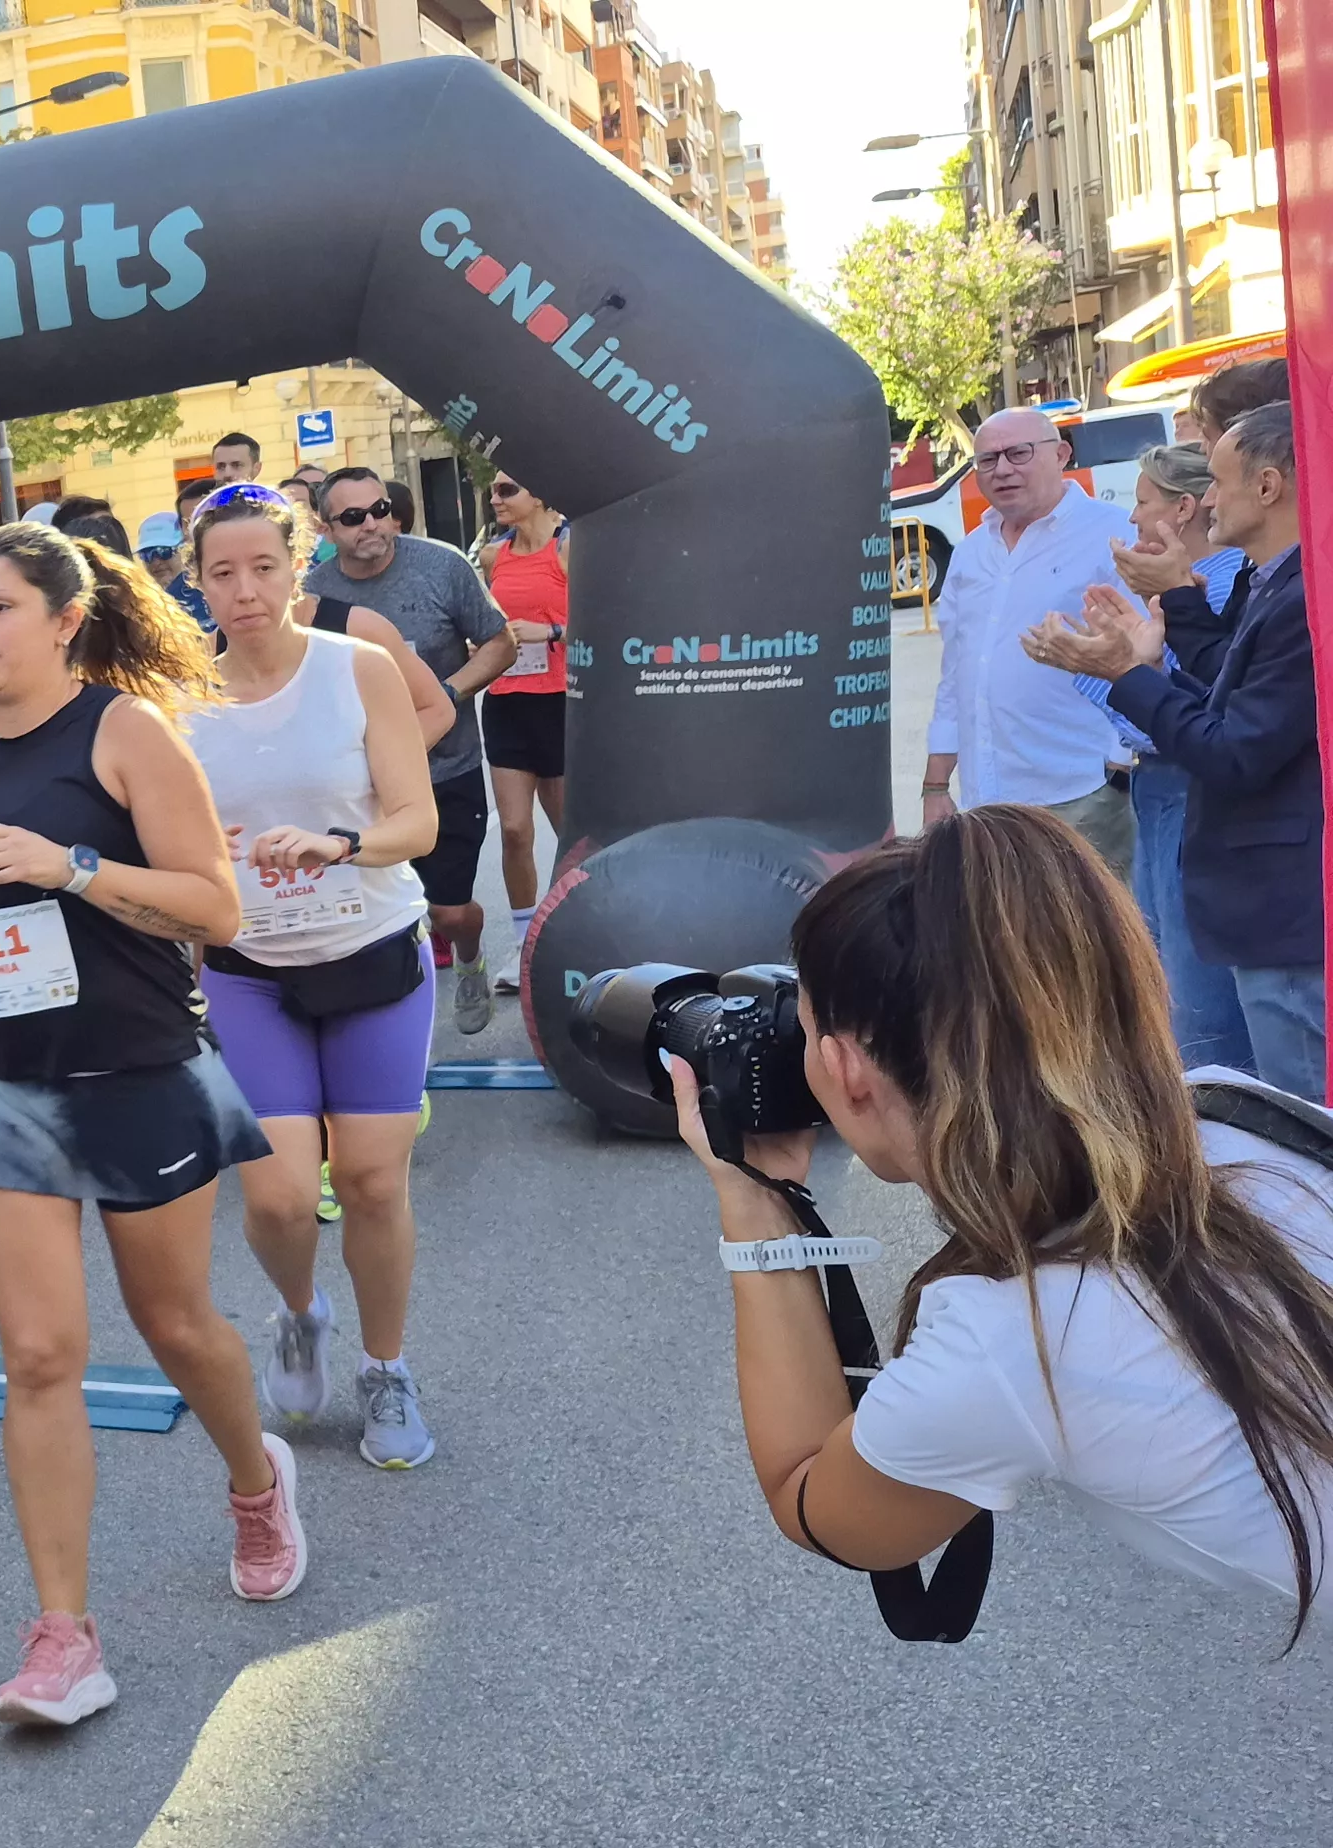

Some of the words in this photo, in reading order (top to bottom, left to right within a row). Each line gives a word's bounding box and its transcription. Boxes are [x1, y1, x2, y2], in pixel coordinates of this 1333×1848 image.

[640, 668, 682, 681] Servicio
[683, 667, 699, 680] de
[700, 664, 782, 680] cronometraje
[634, 682, 674, 696] gestión
[675, 682, 692, 694] de
[693, 680, 740, 694] eventos
[741, 676, 804, 692] deportivos
[829, 704, 872, 729] CHIP
[274, 884, 317, 900] ALICIA
